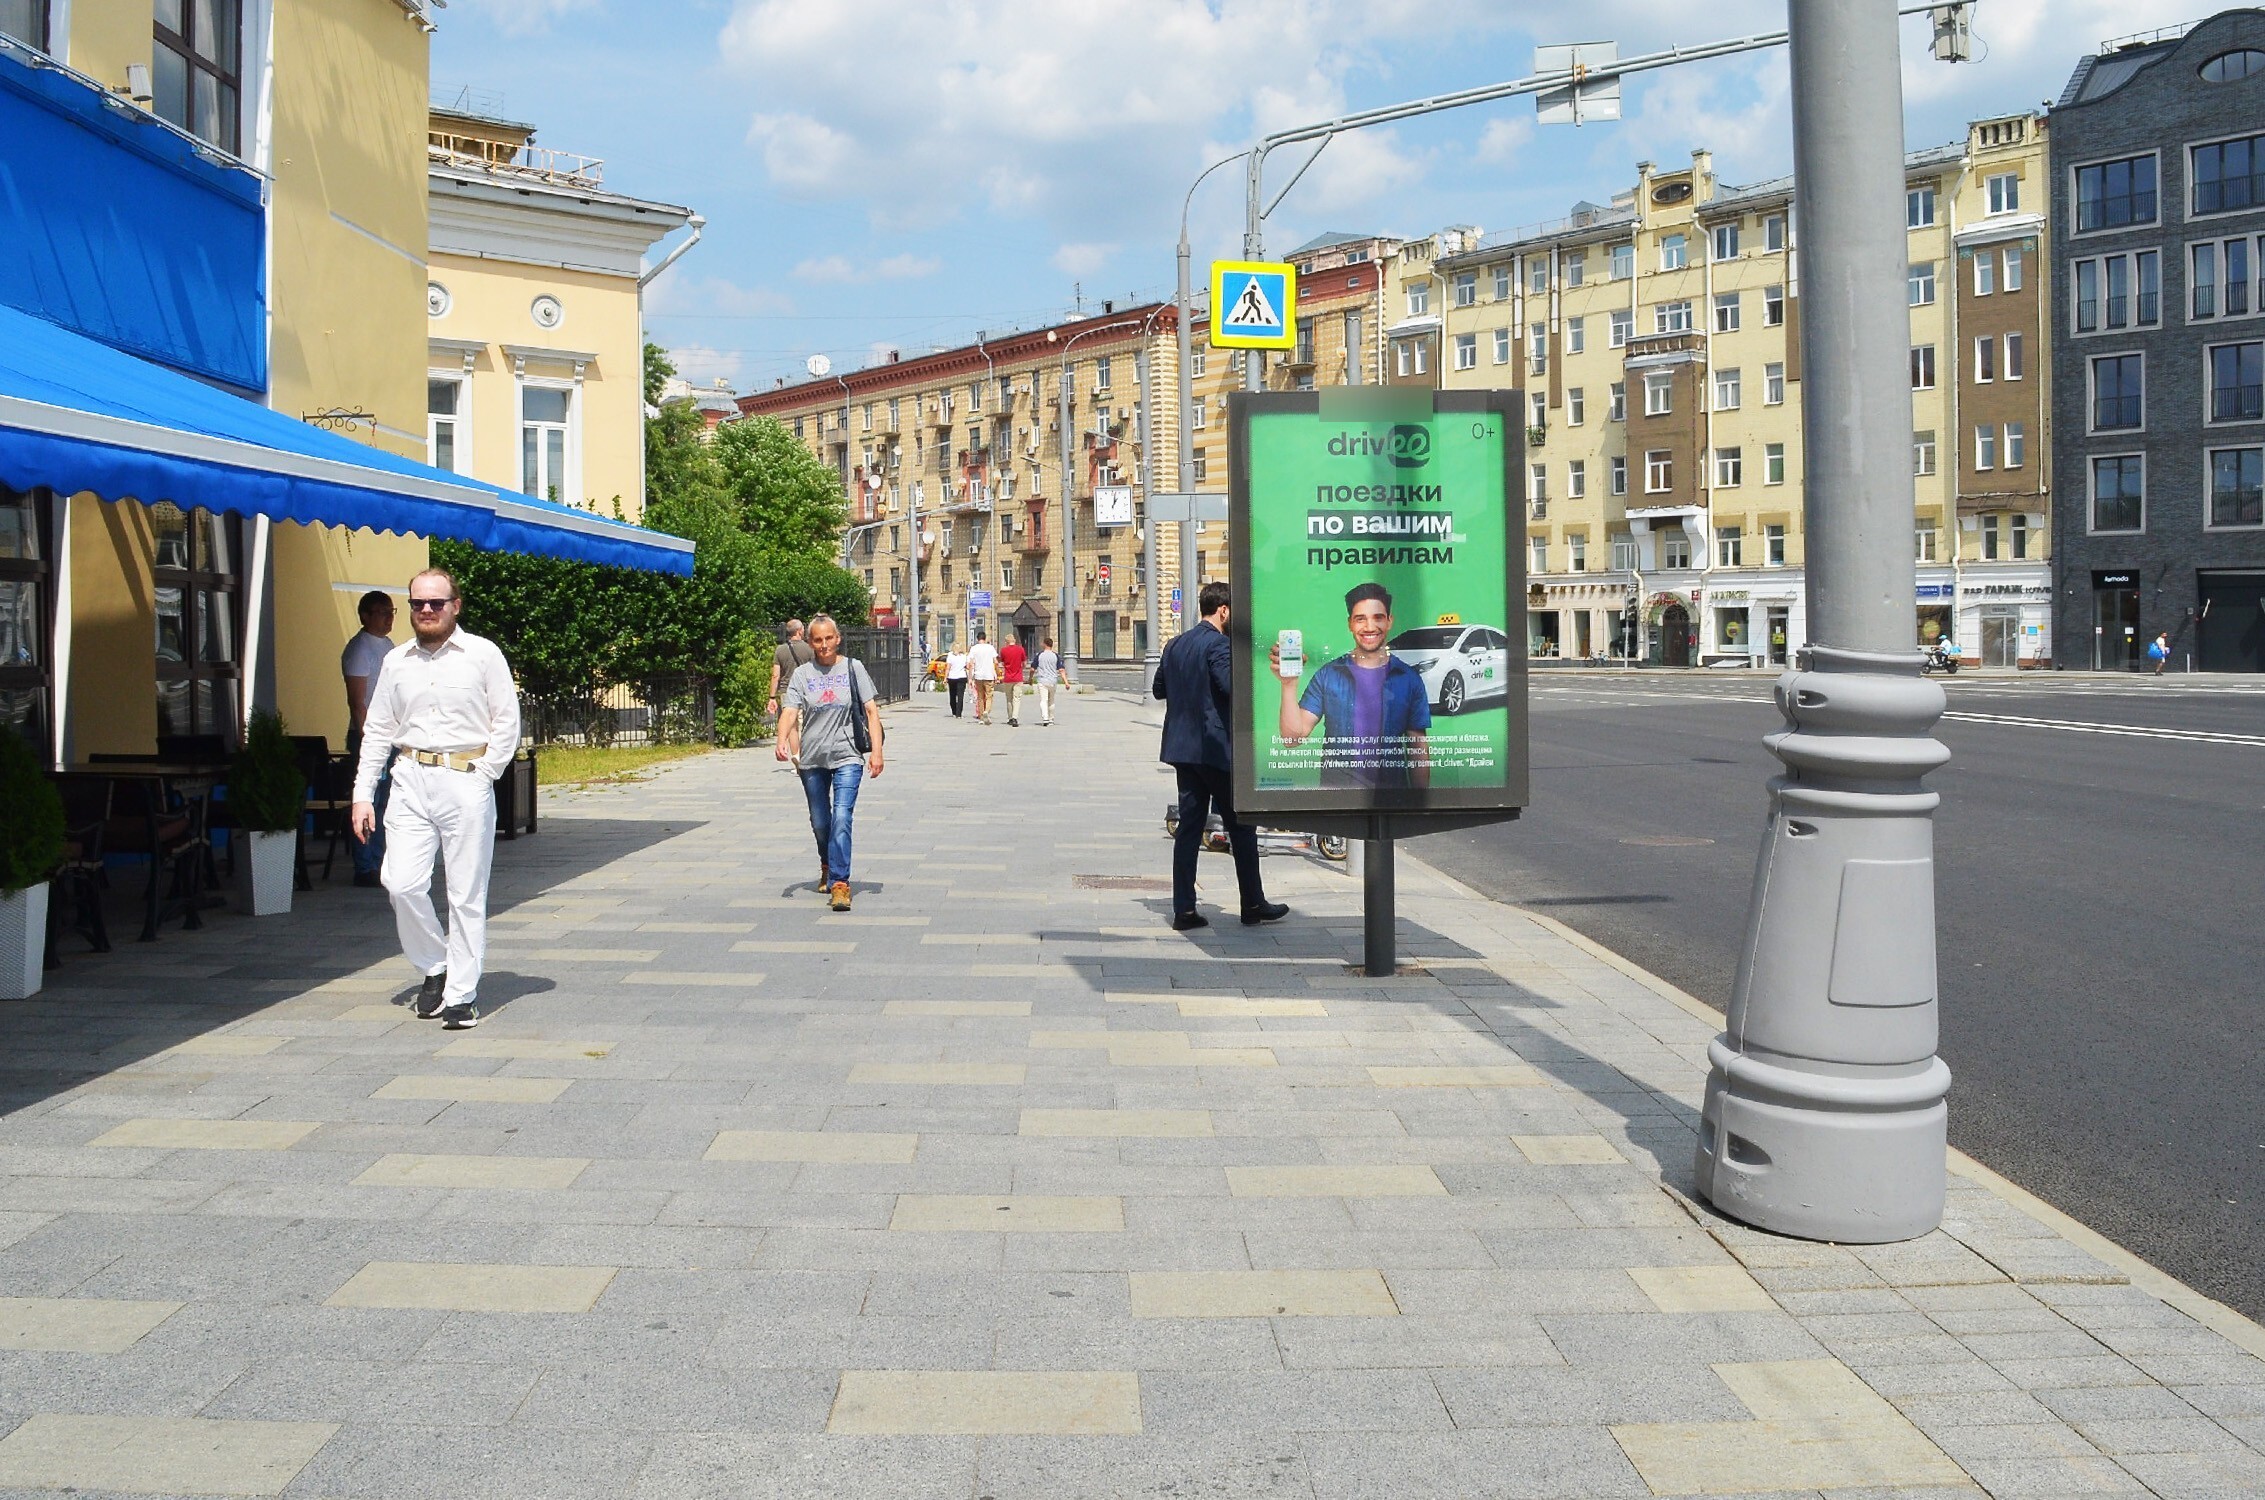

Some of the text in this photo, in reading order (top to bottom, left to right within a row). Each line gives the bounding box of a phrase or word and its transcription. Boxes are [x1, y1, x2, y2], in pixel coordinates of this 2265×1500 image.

[1471, 422, 1495, 440] 0+
[1316, 483, 1443, 507] поездки
[1307, 515, 1453, 535] по вашим
[1307, 546, 1454, 571] правилам
[1984, 584, 2022, 594] ГАРАЖ
[1271, 735, 1293, 744] Drivee
[1337, 736, 1360, 744] заказа
[1361, 736, 1379, 745] услуг
[1279, 748, 1312, 757] является
[1362, 748, 1376, 756] или
[1268, 761, 1277, 769] по
